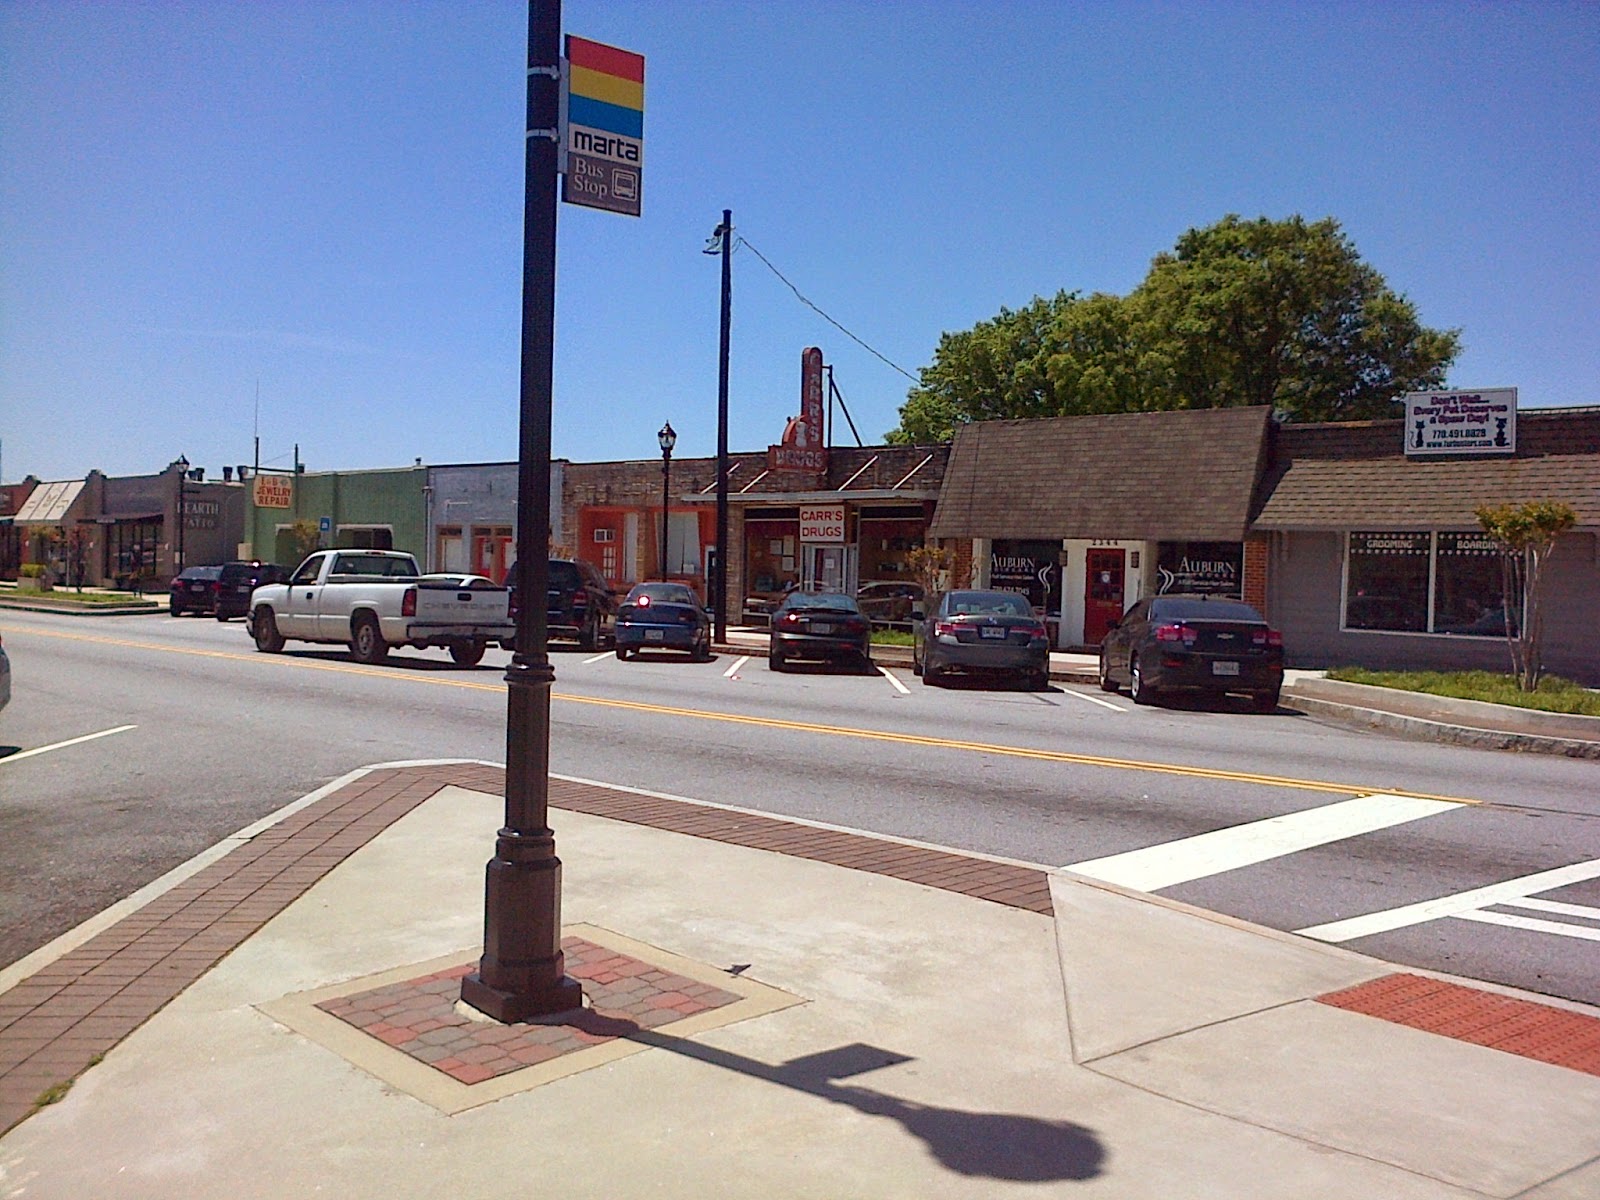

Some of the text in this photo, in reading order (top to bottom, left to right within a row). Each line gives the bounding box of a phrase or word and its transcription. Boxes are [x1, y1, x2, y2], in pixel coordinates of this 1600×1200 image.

[574, 131, 639, 162] marta
[575, 158, 604, 178] Bus
[574, 174, 608, 199] Stop
[1443, 405, 1459, 414] Pet
[257, 486, 291, 497] JEWELRY
[258, 495, 289, 506] REPAIR
[801, 510, 843, 521] CARR'S
[802, 526, 842, 537] DRUGS
[1366, 540, 1413, 549] GROOMING
[1456, 540, 1499, 550] BOARDIN
